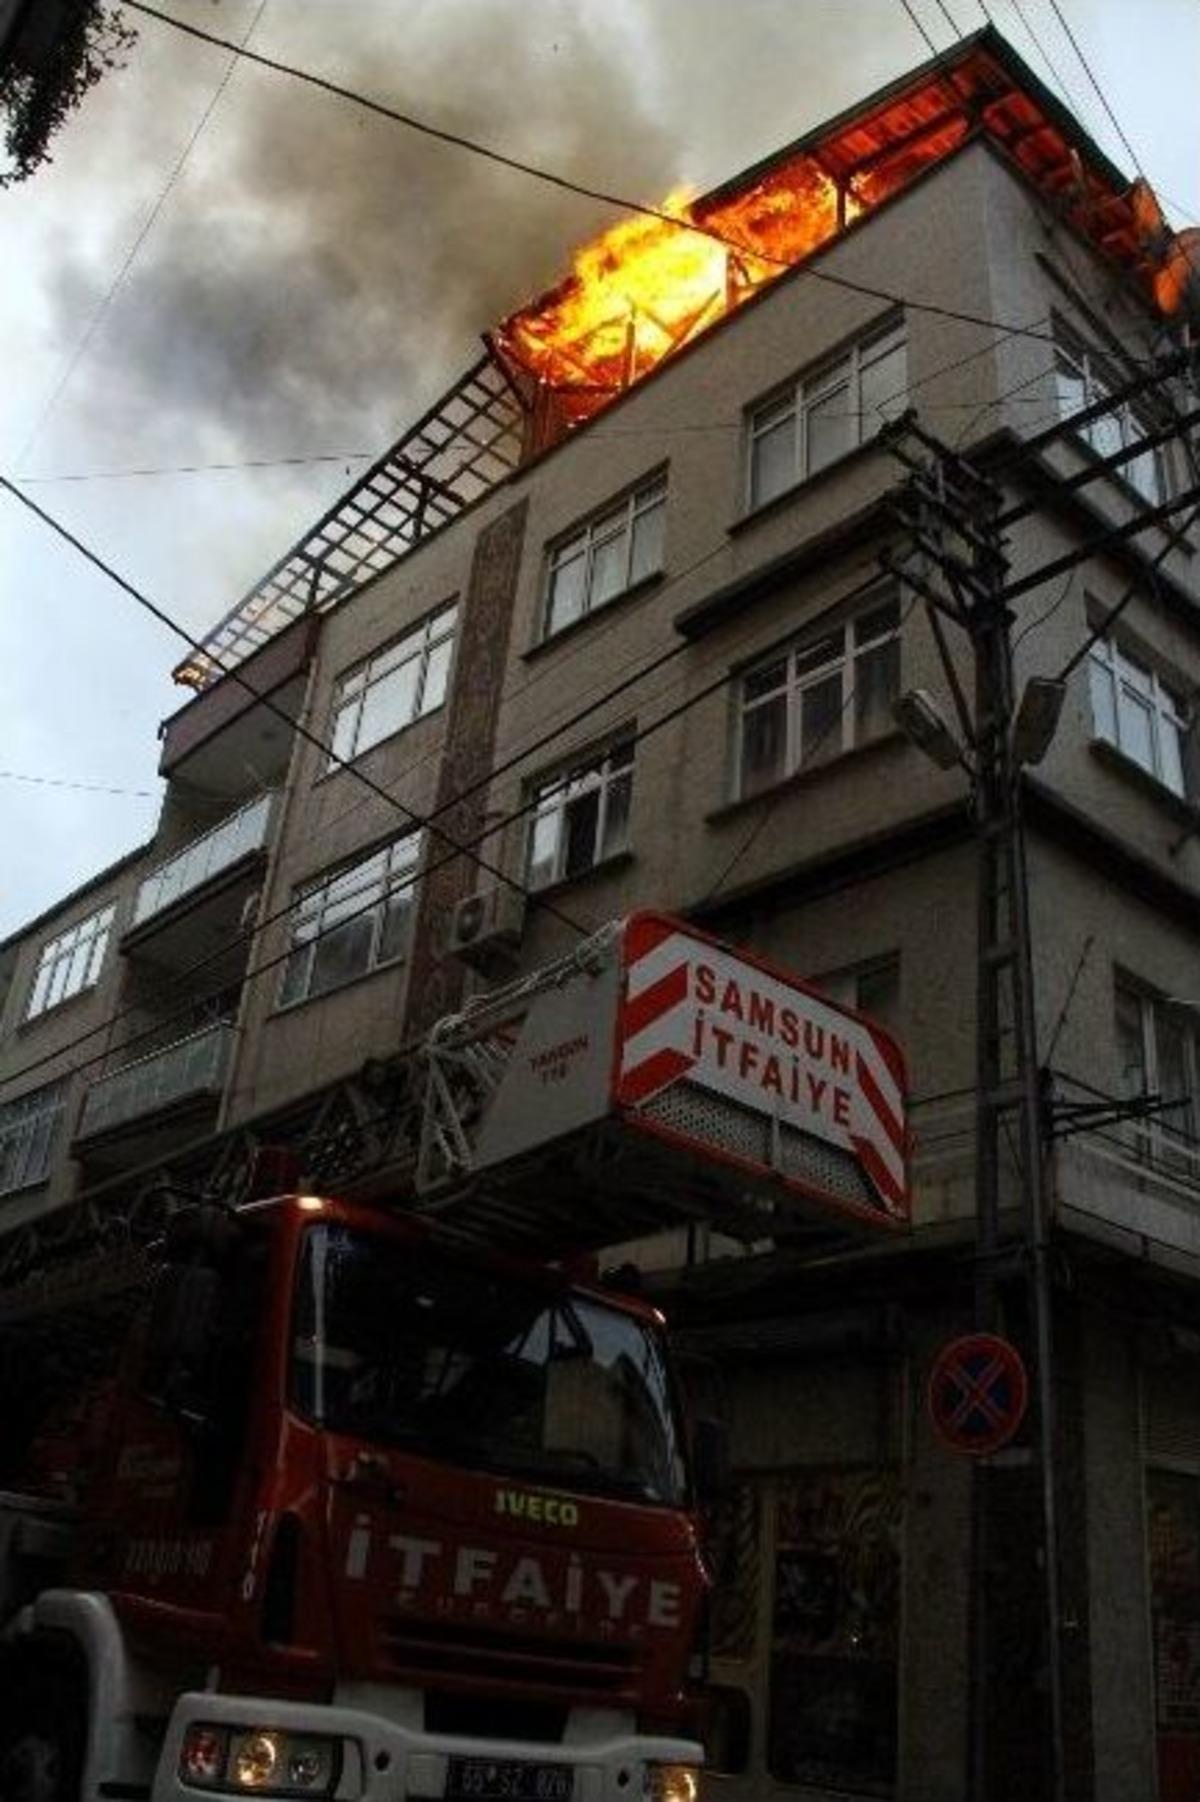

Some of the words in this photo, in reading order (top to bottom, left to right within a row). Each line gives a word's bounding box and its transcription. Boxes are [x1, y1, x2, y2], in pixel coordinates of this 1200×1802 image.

[693, 1009, 850, 1127] İTFAİYE
[696, 964, 849, 1075] SAMSUN
[495, 1489, 579, 1526] IVECO
[344, 1512, 682, 1628] İTFAİYE
